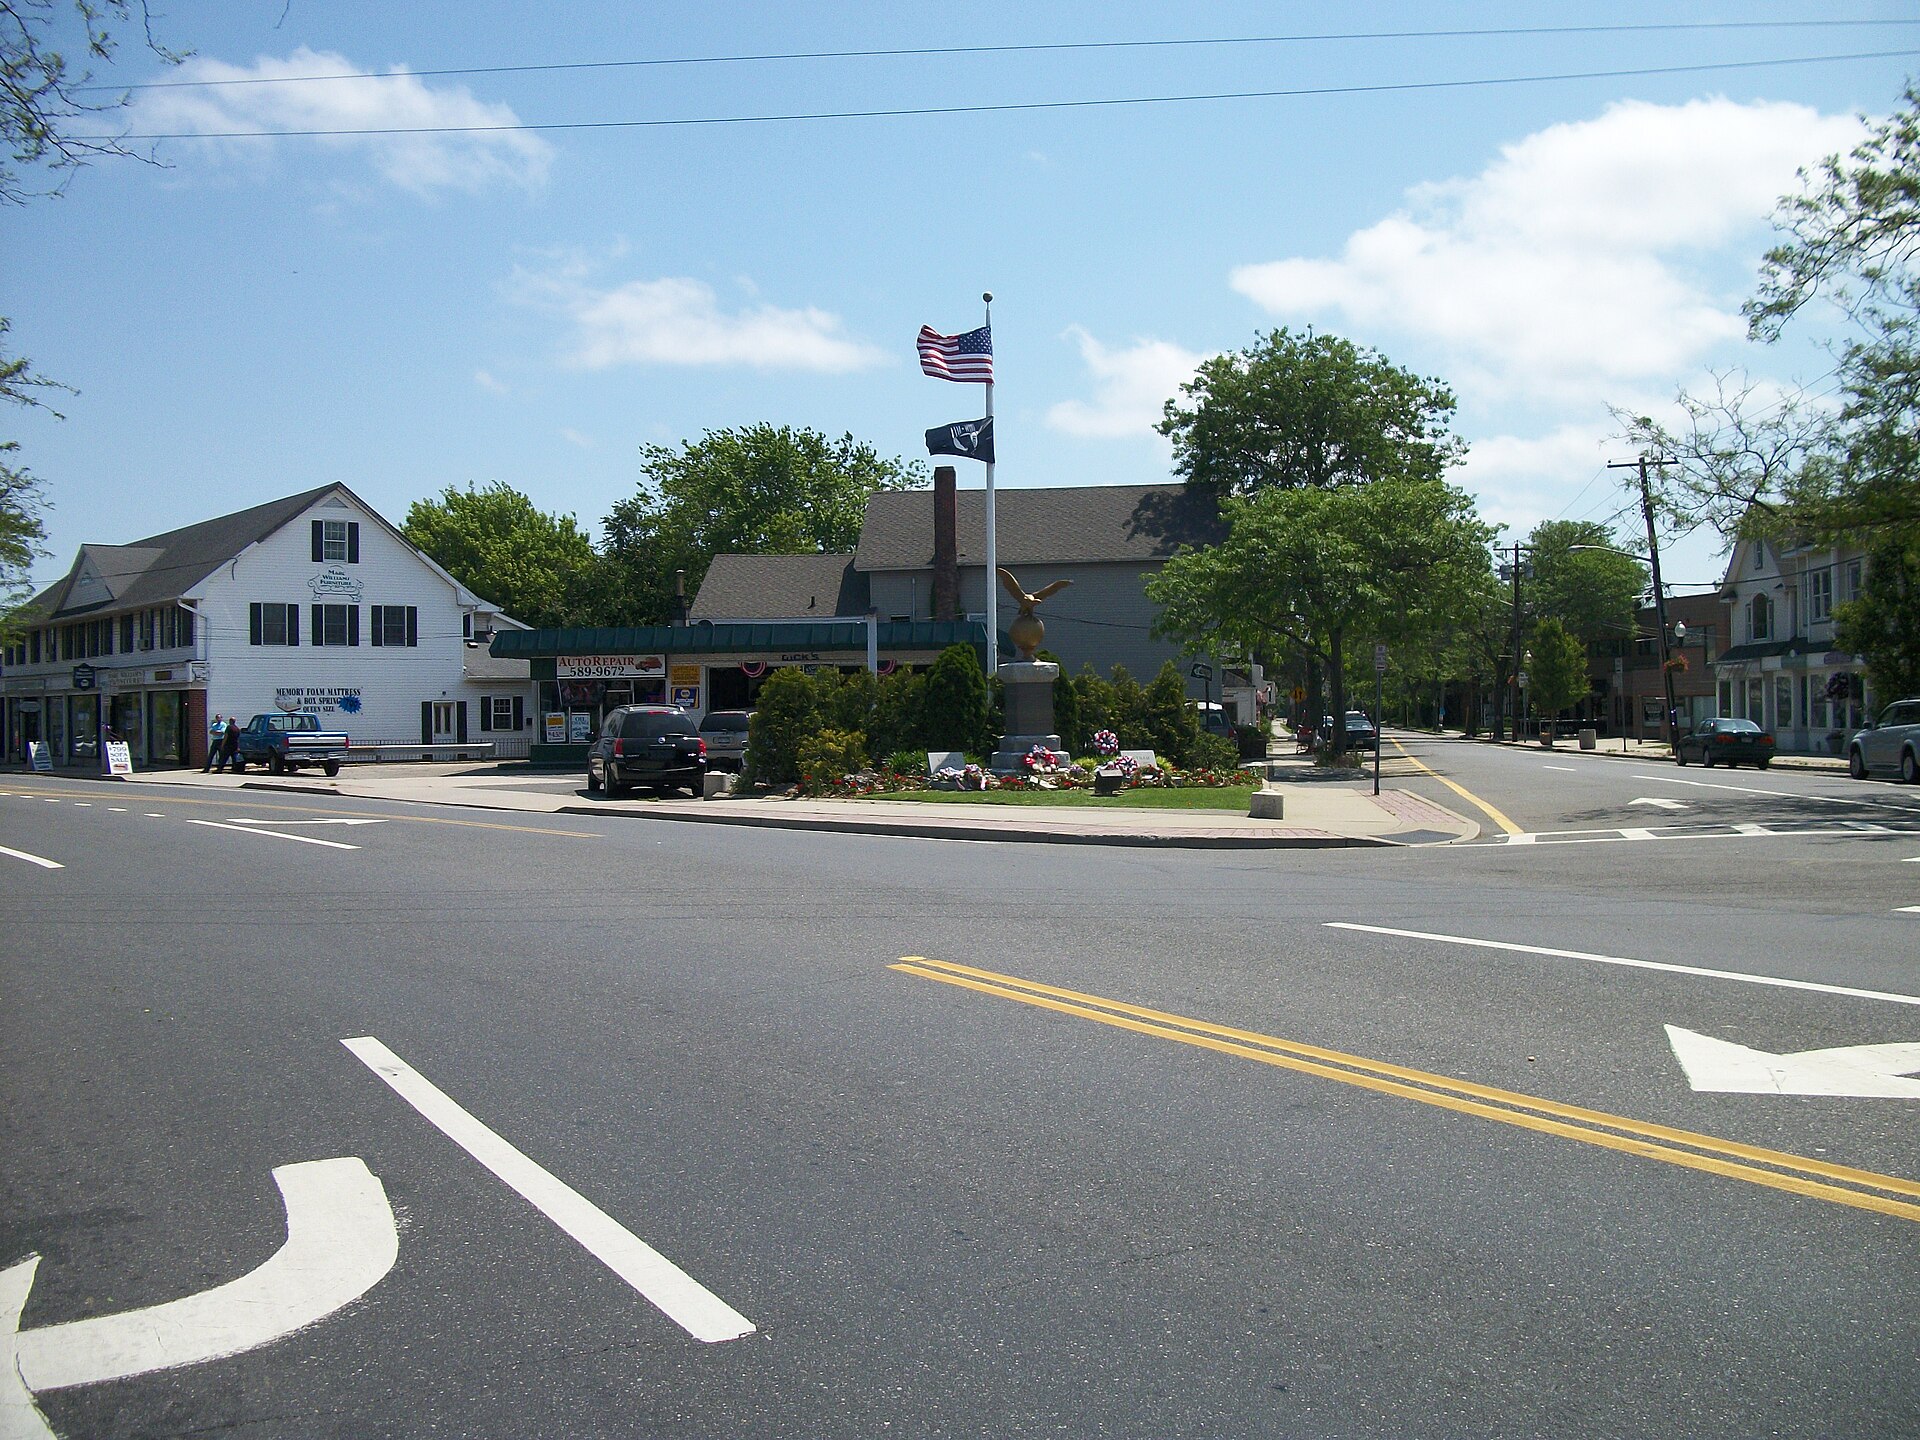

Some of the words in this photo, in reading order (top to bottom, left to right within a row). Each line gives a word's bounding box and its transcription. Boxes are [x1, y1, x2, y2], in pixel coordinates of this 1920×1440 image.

[569, 666, 625, 677] 589-9672
[276, 688, 304, 696] MEMORY
[306, 688, 325, 696] FOAM
[327, 688, 361, 696] MATTRESS
